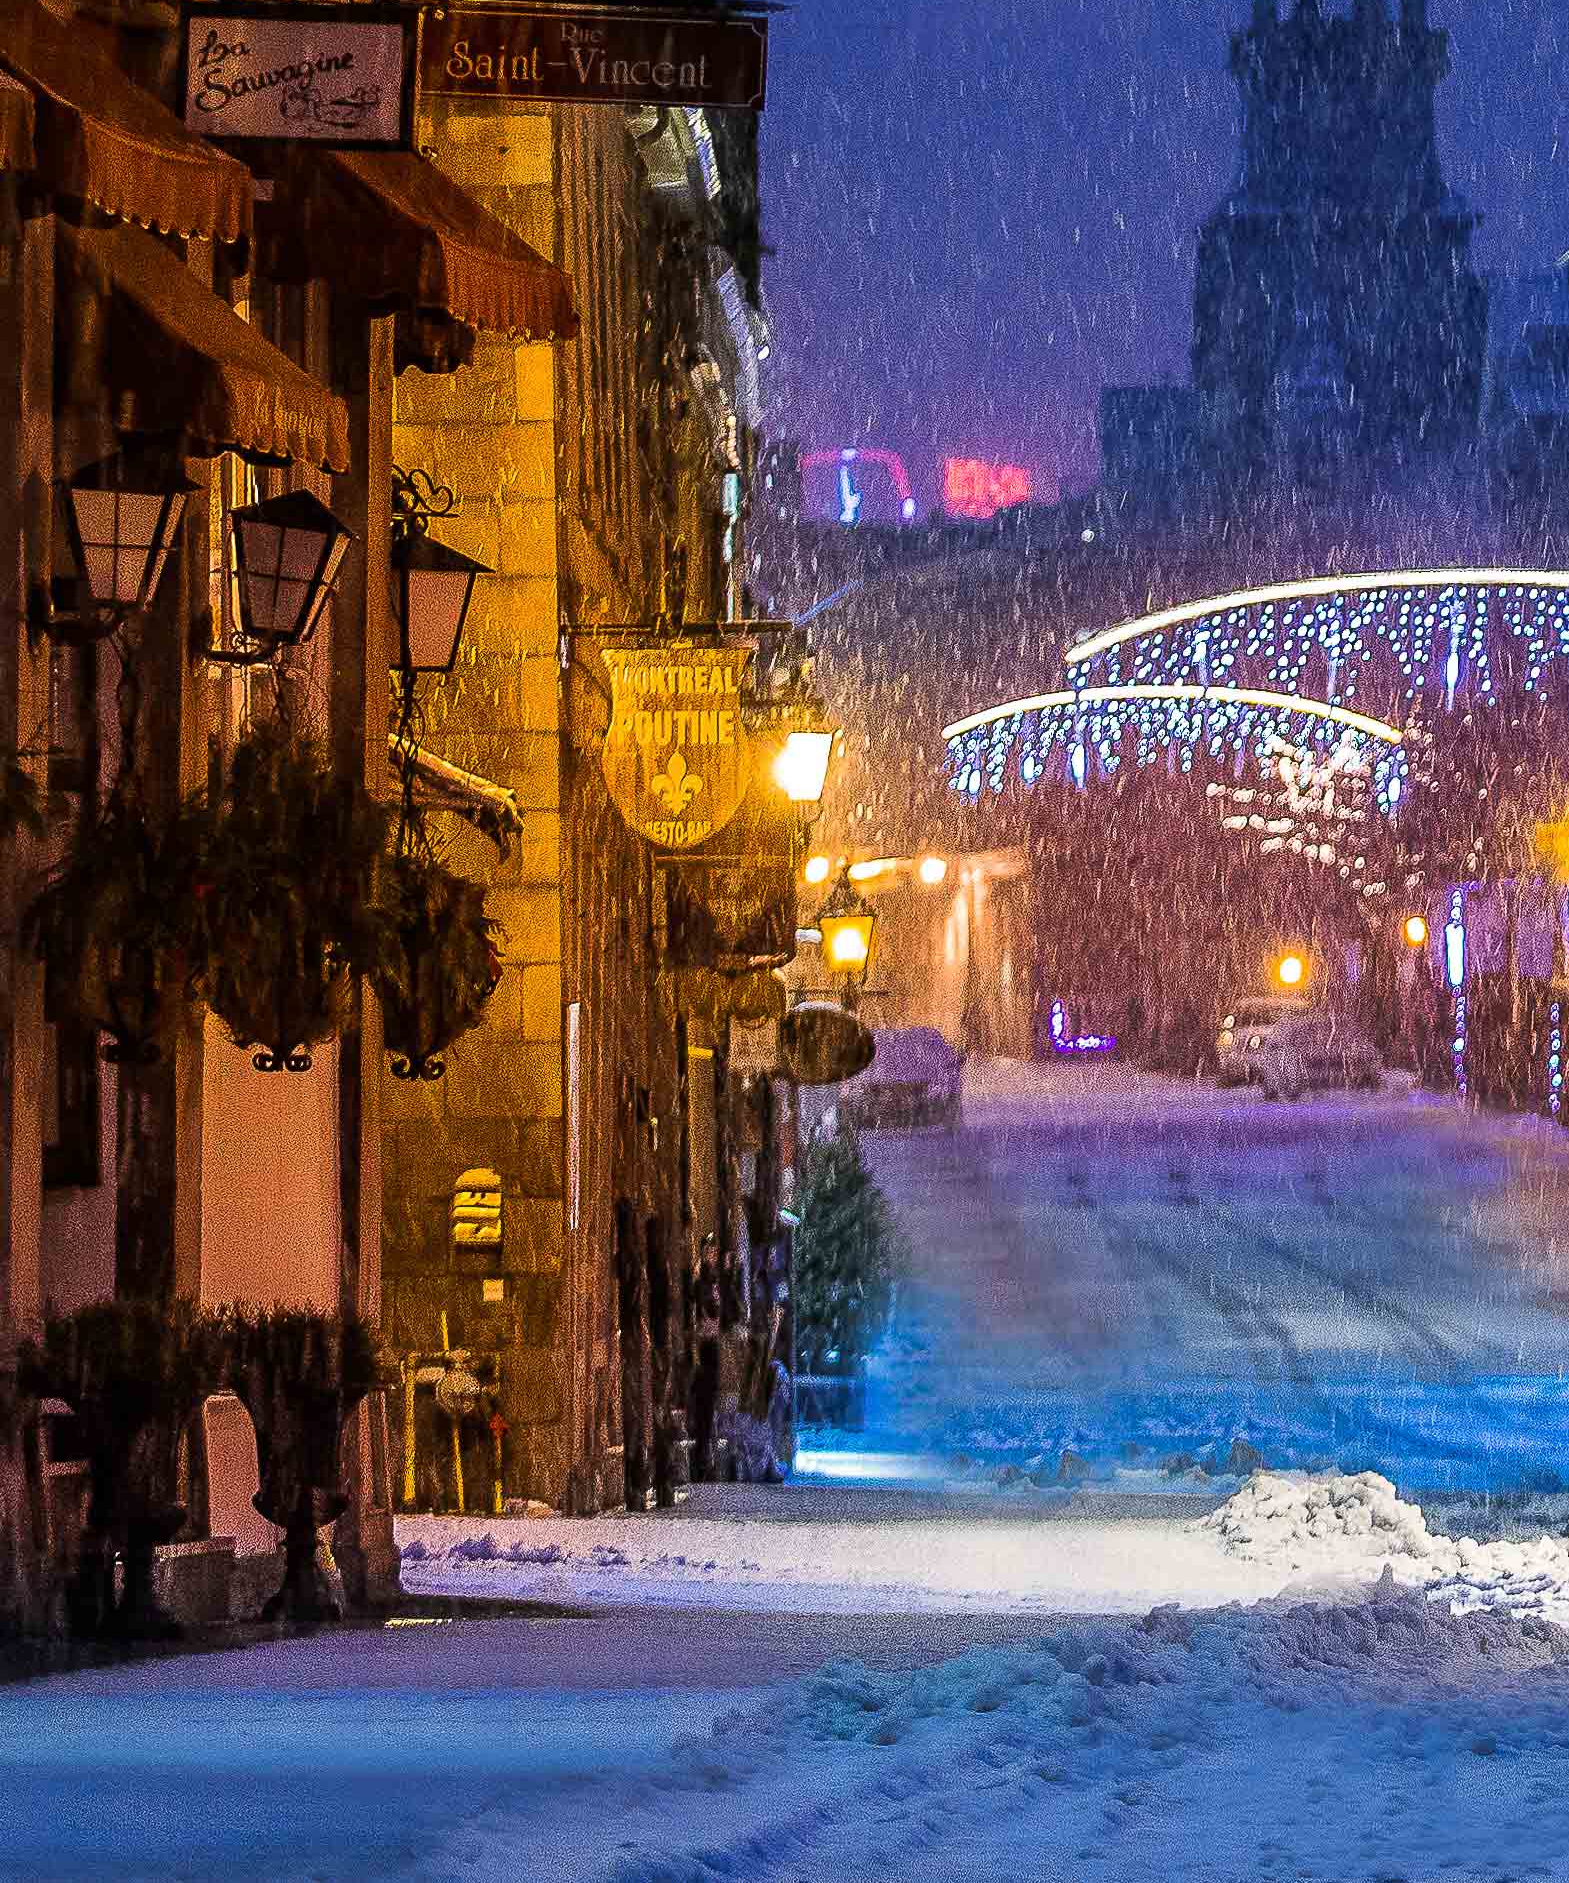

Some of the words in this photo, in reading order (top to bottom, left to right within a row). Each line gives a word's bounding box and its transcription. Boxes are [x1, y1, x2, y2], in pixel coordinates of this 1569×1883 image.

[199, 28, 251, 68] La
[560, 21, 602, 44] Rue
[195, 52, 354, 113] Sauvagine
[446, 40, 712, 90] Saint-Vincent
[616, 709, 735, 745] POUTINE
